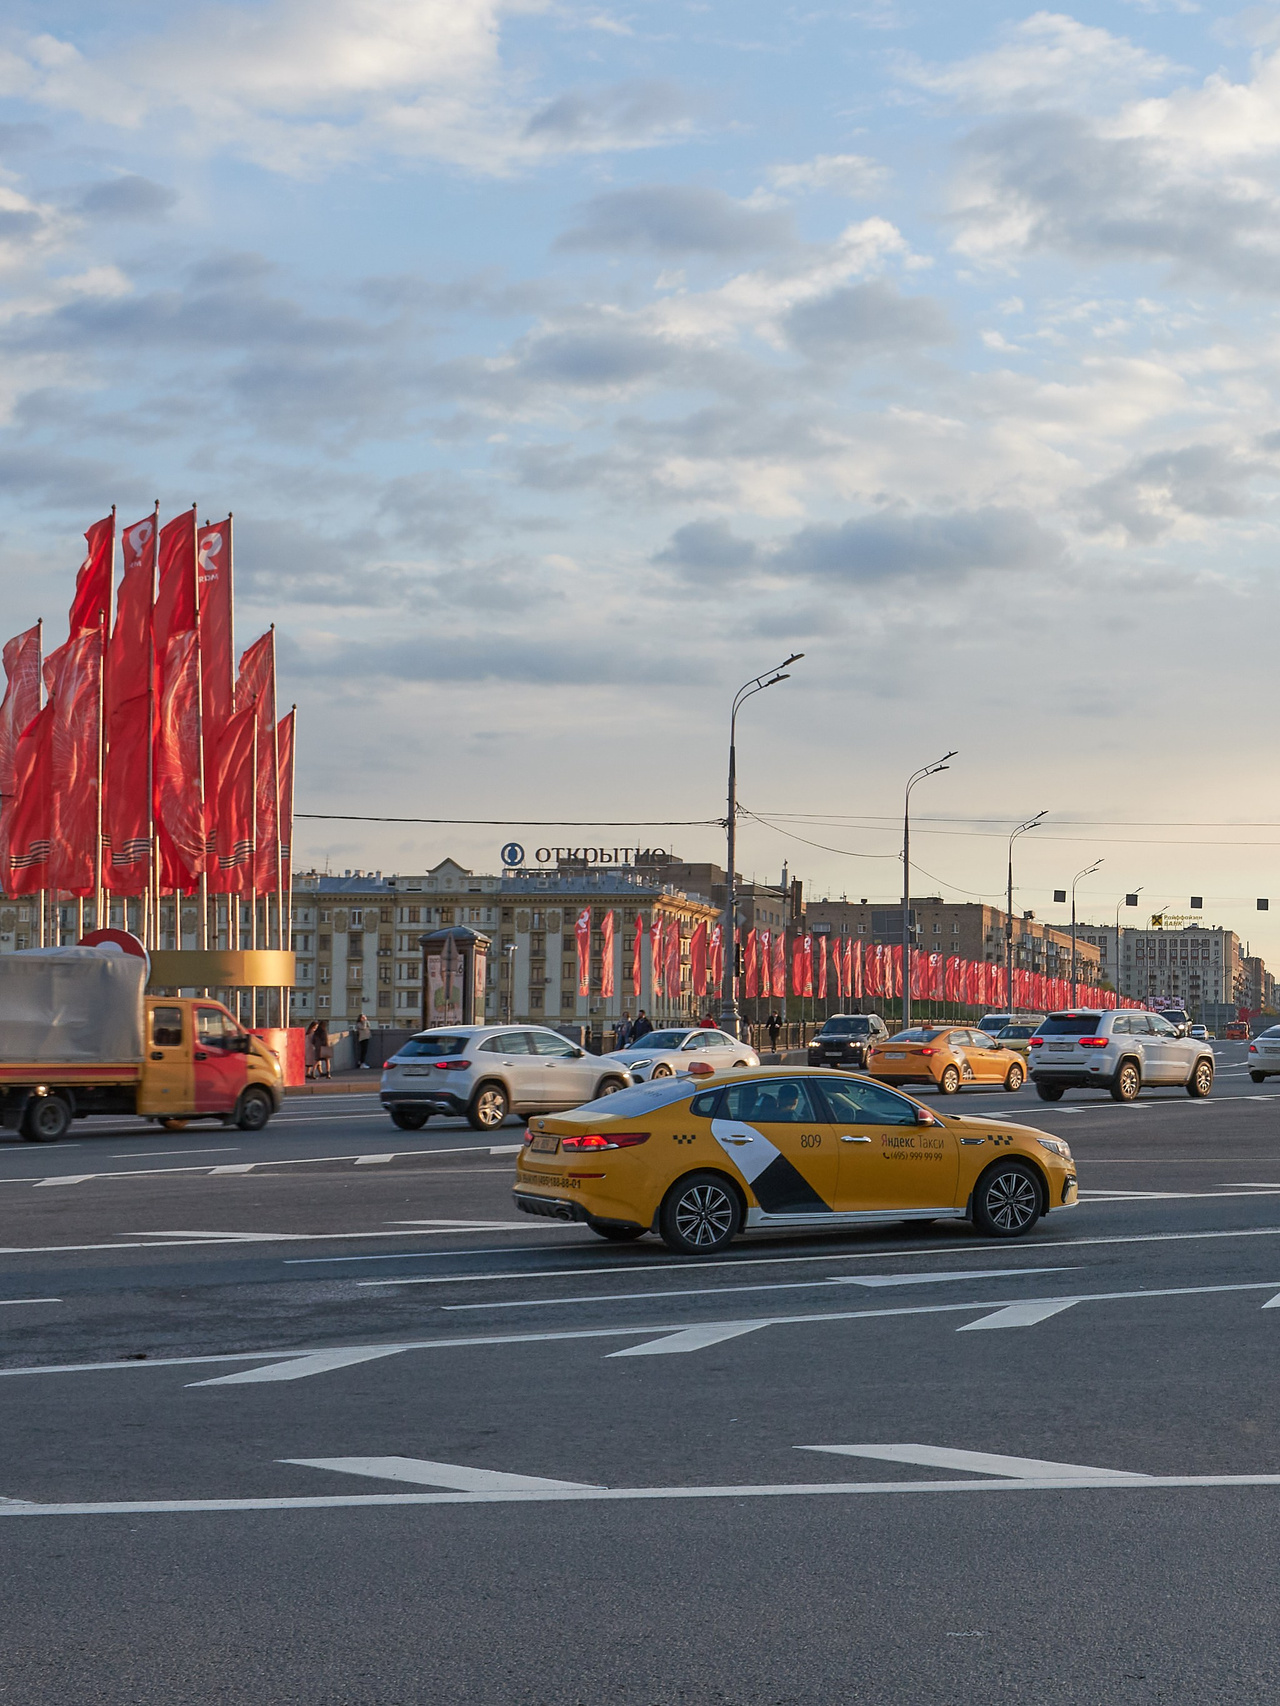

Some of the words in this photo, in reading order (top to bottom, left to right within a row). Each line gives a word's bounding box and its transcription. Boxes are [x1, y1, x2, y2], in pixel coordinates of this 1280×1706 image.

[800, 1134, 822, 1148] 809
[881, 1134, 916, 1148] Яндекс
[918, 1134, 945, 1149] Такси
[890, 1152, 909, 1161] (495)
[909, 1153, 923, 1161] 999
[924, 1153, 933, 1161] 99
[934, 1153, 943, 1161] 99
